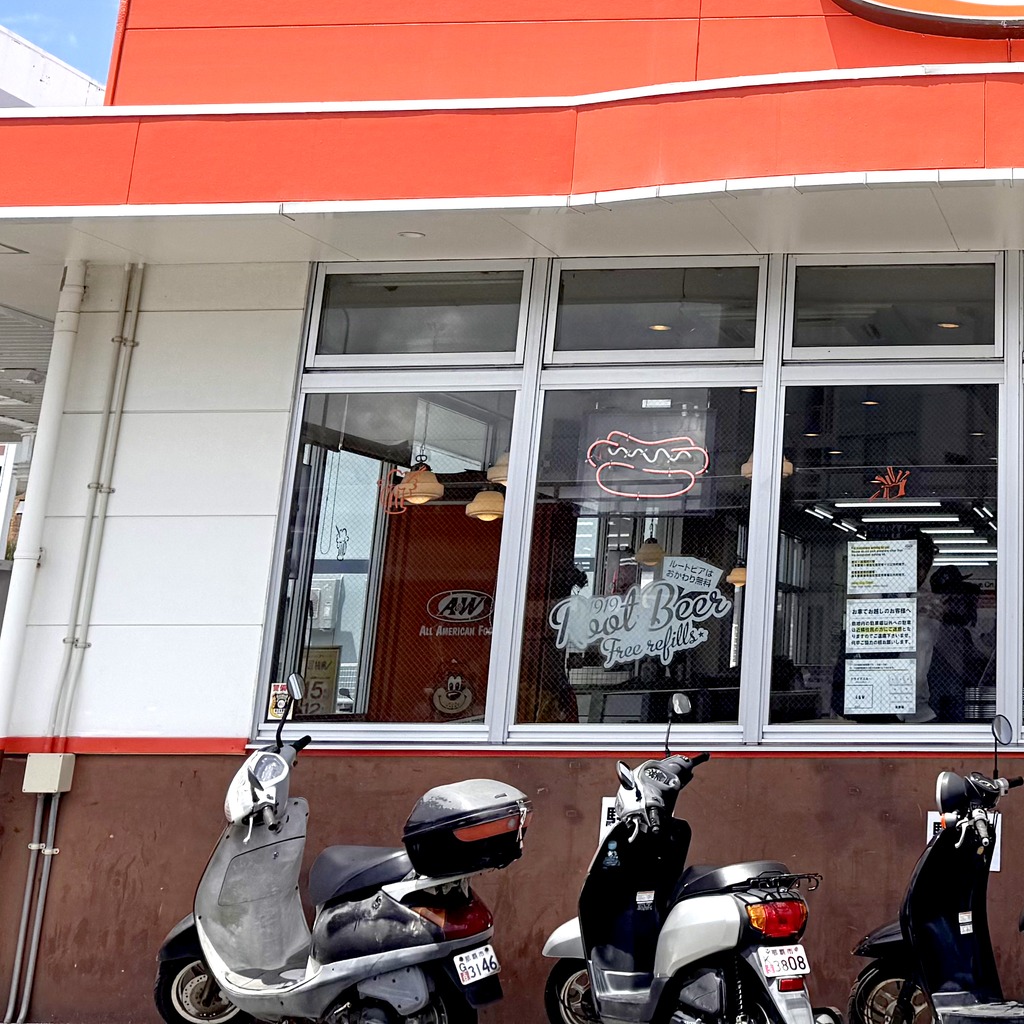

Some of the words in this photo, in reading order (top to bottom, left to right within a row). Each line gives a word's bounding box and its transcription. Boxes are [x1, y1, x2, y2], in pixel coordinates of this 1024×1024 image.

[666, 570, 711, 588] おかわり無料
[648, 583, 728, 631] Beer
[603, 637, 643, 663] Free
[647, 623, 697, 660] refills
[468, 954, 498, 978] 3146
[773, 955, 807, 972] 3808
